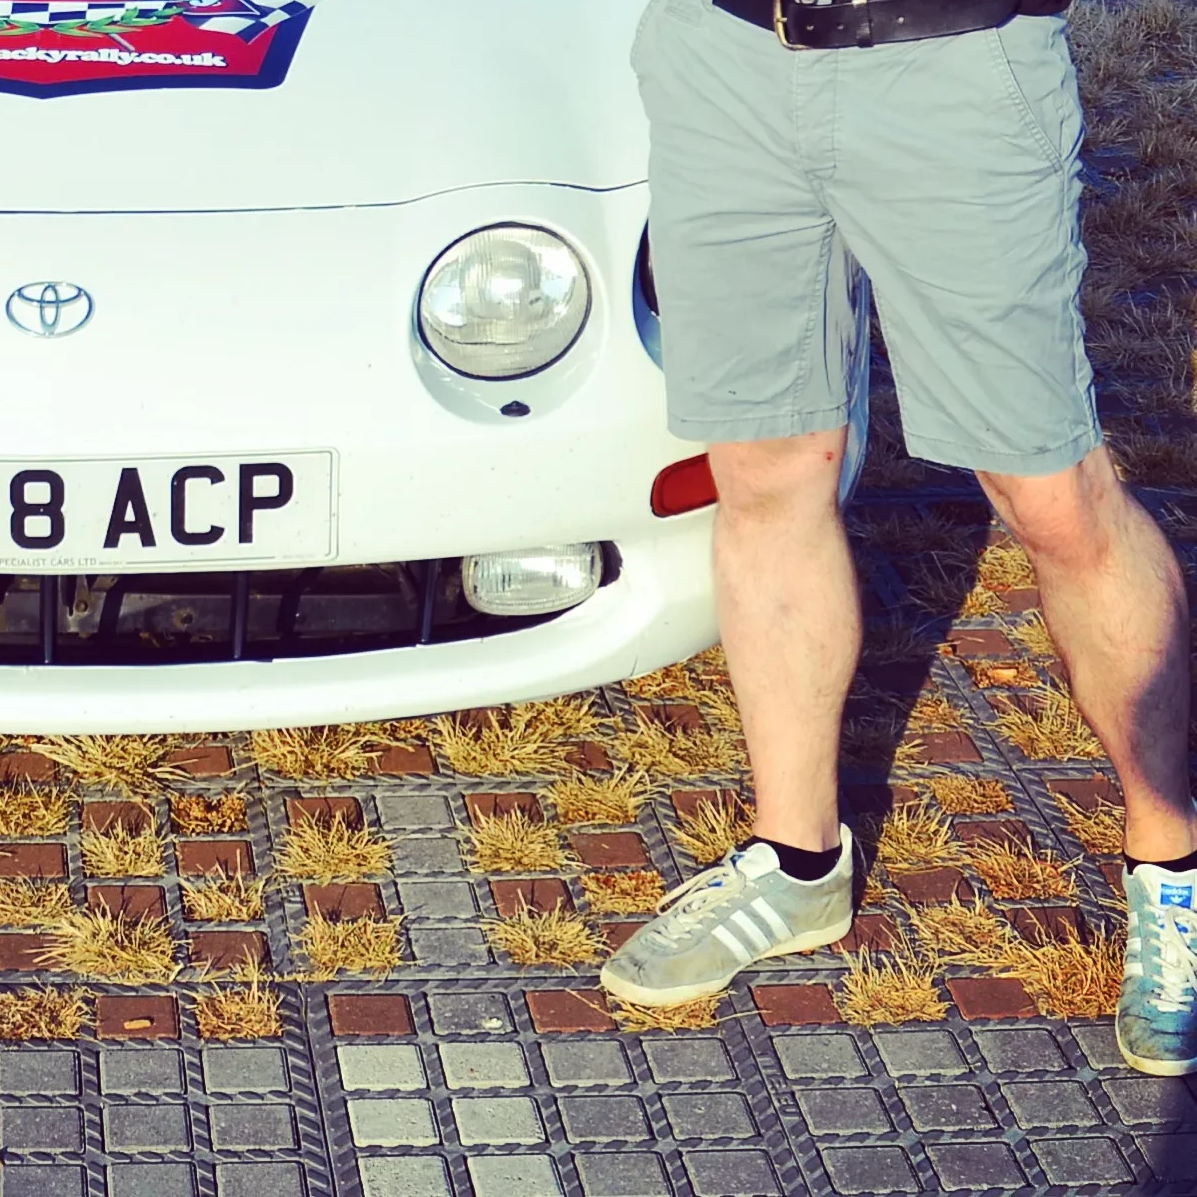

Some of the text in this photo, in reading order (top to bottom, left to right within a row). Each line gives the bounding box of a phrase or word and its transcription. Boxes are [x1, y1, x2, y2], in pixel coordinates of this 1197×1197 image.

[103, 462, 294, 549] ACP
[49, 557, 76, 567] CARS
[78, 557, 98, 567] LTD
